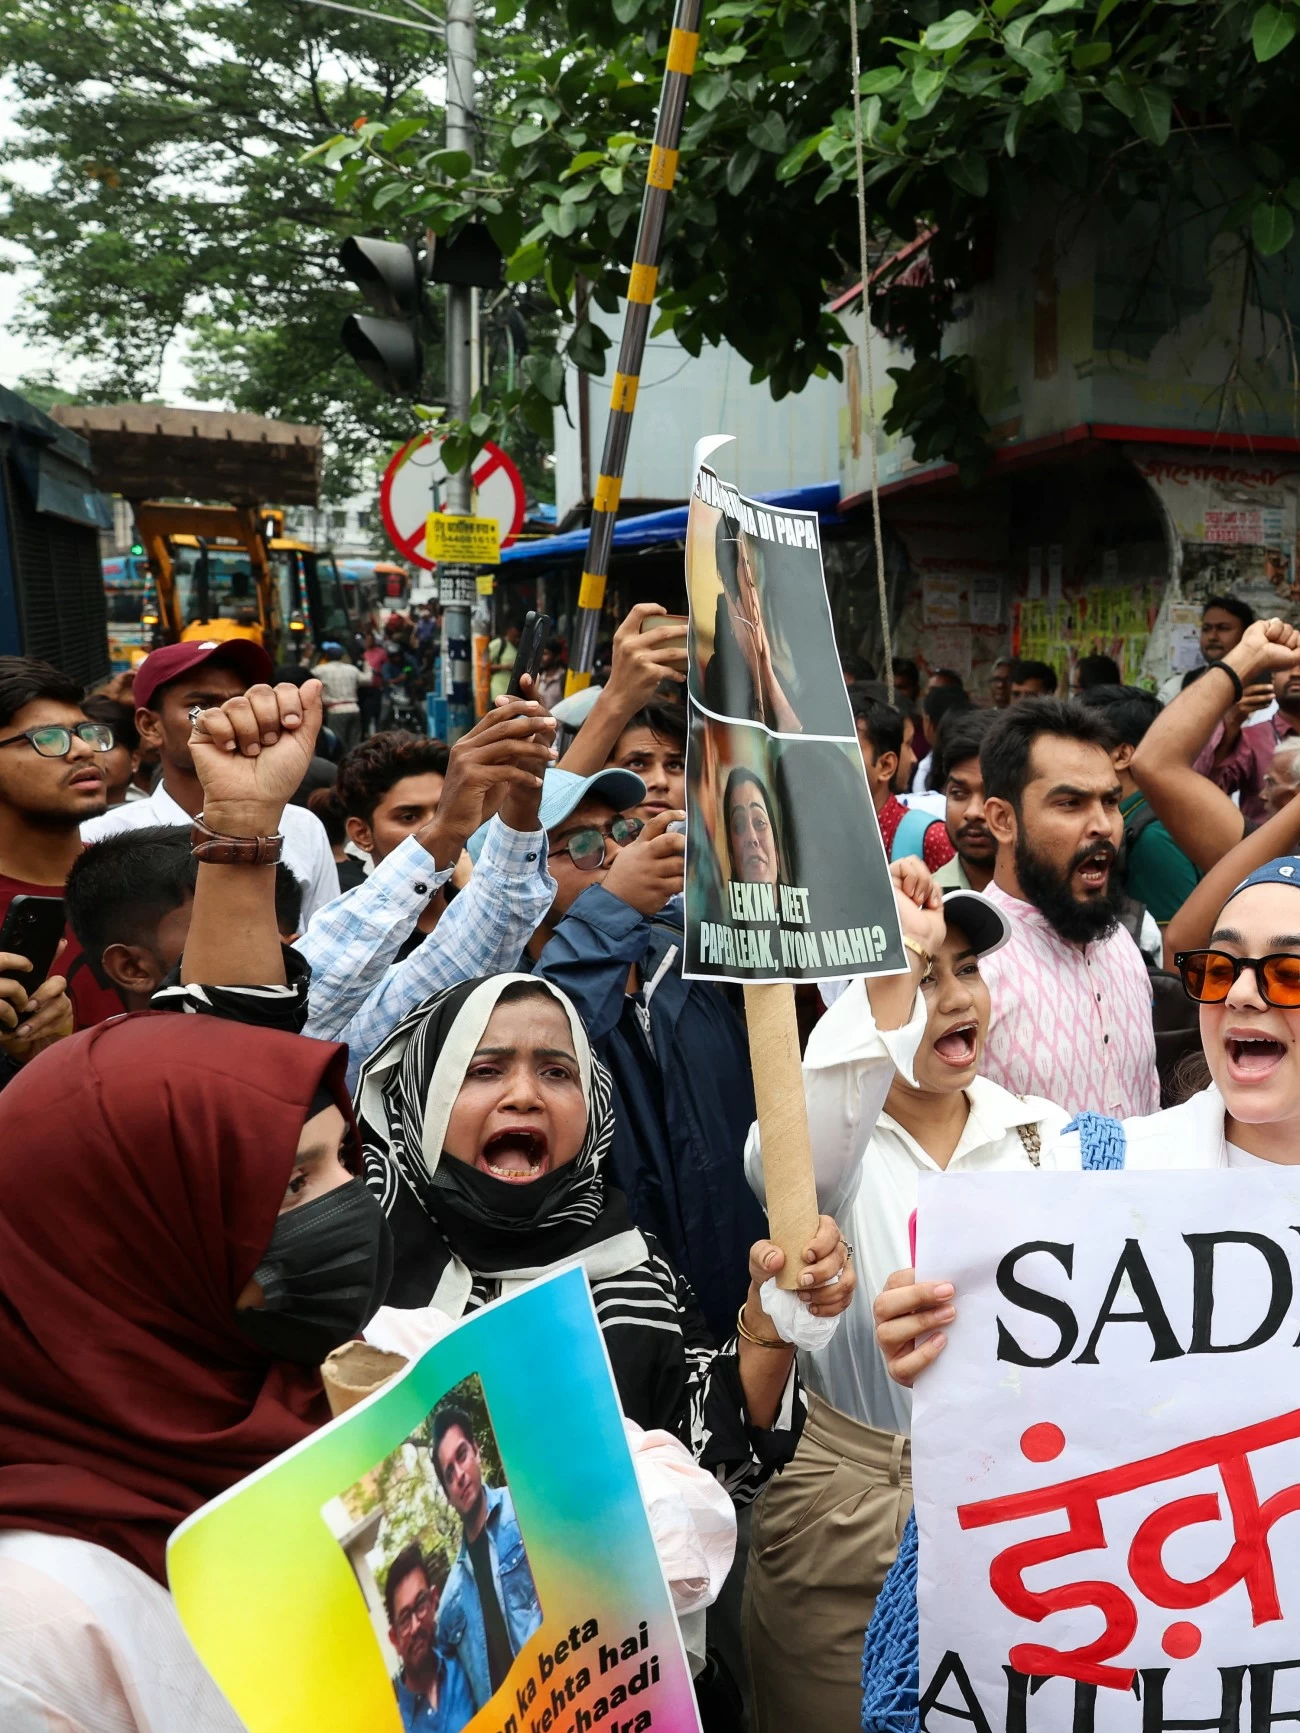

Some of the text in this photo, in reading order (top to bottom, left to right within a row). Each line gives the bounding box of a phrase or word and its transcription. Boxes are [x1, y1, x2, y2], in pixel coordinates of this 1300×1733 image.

[756, 510, 775, 542] DI
[774, 515, 818, 550] PAPA
[728, 881, 811, 925] LEKIN, NEET
[780, 929, 821, 969] KYON
[820, 925, 887, 967] NAHI?
[516, 1677, 537, 1720] ka
[538, 1618, 599, 1684] beta
[599, 1620, 649, 1675] hai
